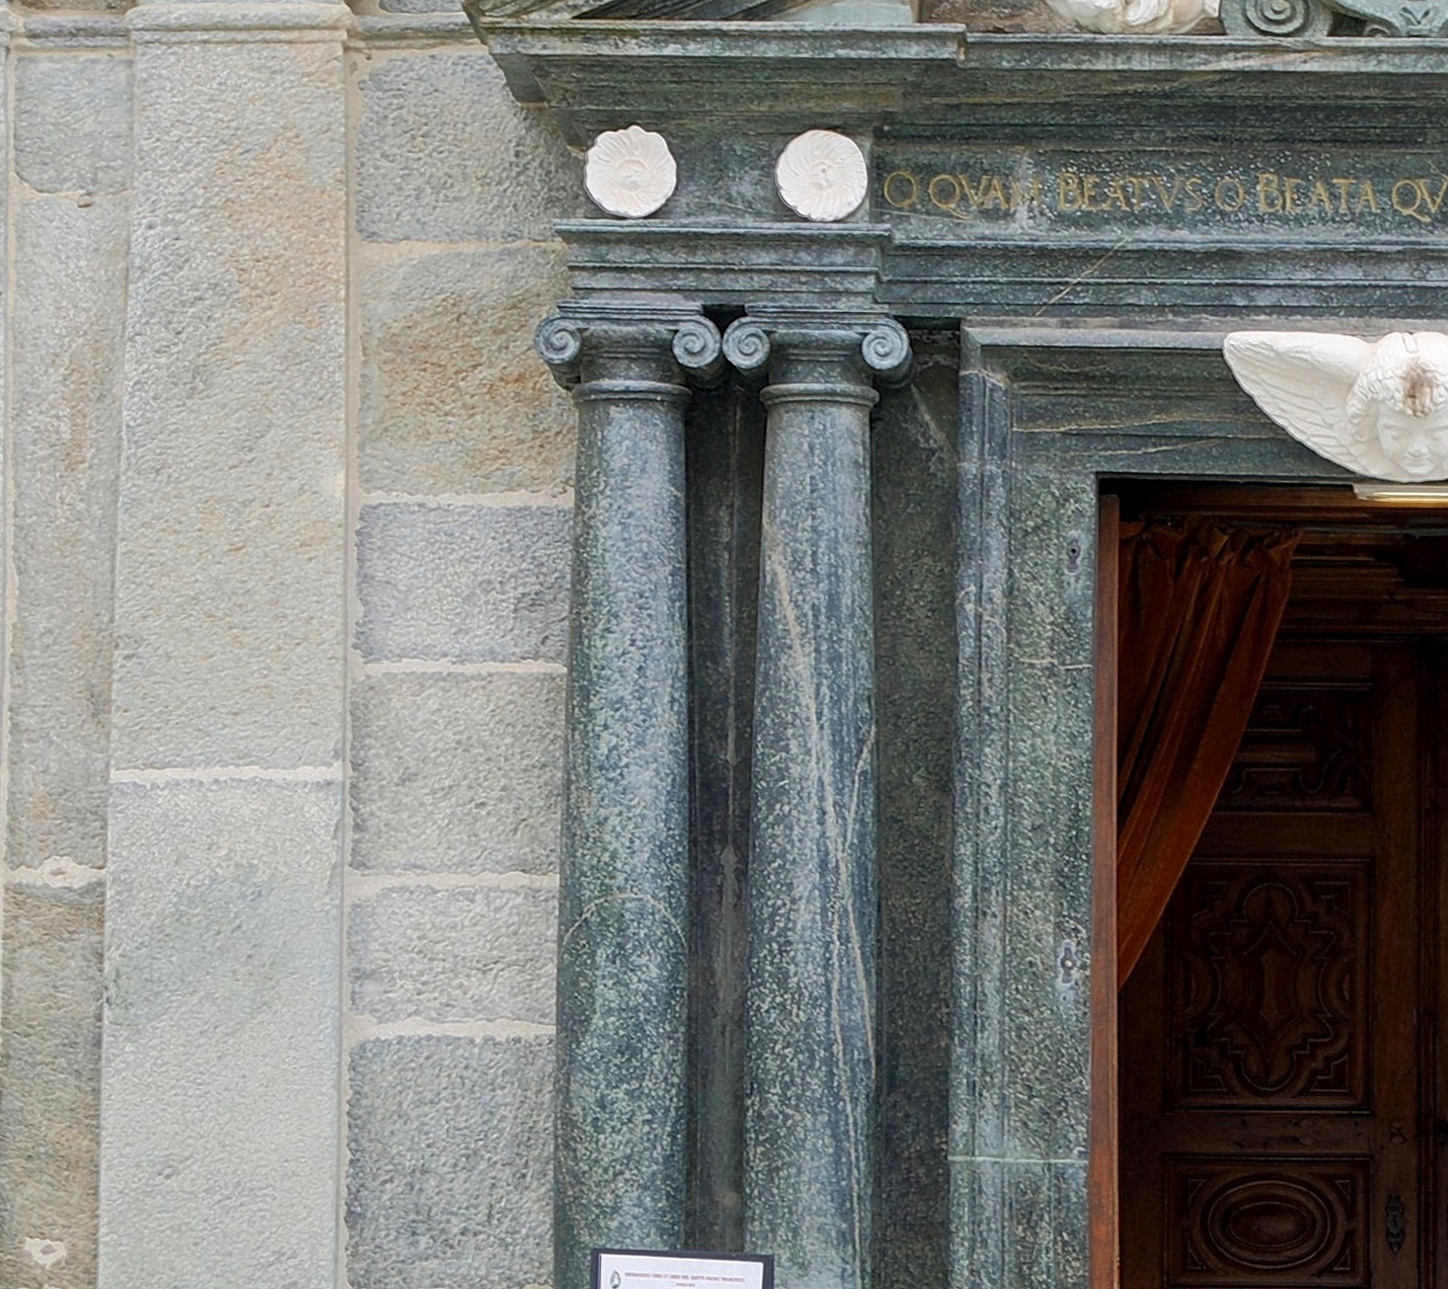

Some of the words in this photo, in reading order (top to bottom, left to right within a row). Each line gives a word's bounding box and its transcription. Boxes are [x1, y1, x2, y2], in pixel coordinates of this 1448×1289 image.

[884, 170, 918, 209] O
[1057, 172, 1203, 212] BEATVS
[1214, 173, 1246, 212] O
[1257, 172, 1380, 215] BEATA
